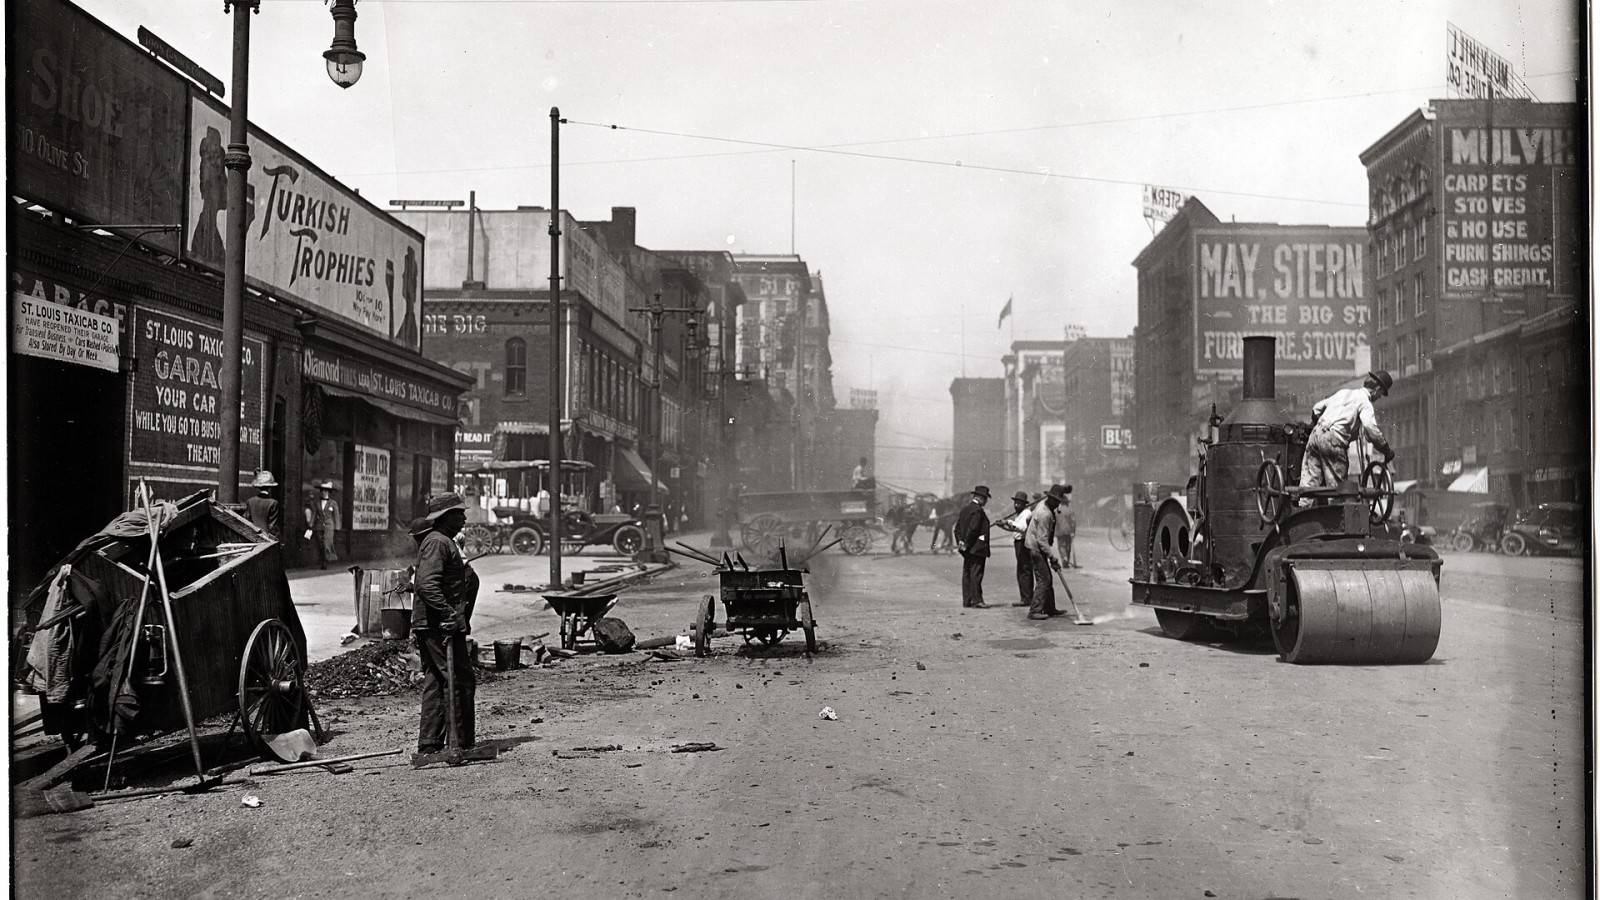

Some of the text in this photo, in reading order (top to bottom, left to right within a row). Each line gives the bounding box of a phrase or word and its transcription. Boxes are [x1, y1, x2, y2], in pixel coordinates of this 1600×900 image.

[32, 48, 124, 139] SHOE
[38, 134, 69, 171] OLIVE
[73, 151, 90, 180] ST.
[1445, 174, 1528, 192] CARPETS
[261, 165, 350, 241] TURKISH
[1454, 197, 1527, 214] STOVES
[1461, 221, 1528, 239] HOUSE
[288, 228, 376, 288] TROPHIES
[1446, 244, 1553, 262] FURNISHINGS
[1200, 243, 1364, 301] MAY, STERN
[1447, 267, 1489, 287] CASH
[21, 301, 114, 335] ST. LOUIS TAXICAB CO.
[375, 299, 383, 312] 10
[1248, 305, 1288, 324] THE
[1298, 305, 1333, 324] BIG
[25, 316, 41, 328] HAVE
[43, 320, 72, 335] REOPENED
[74, 327, 90, 338] THEIR
[423, 314, 487, 333] NE BIG
[28, 337, 40, 350] Also
[41, 339, 57, 353] Stored
[59, 343, 66, 356] By
[67, 345, 76, 359] Day
[75, 336, 86, 348] Cars
[145, 319, 163, 342] ST.
[163, 323, 194, 350] LOUIS
[198, 334, 223, 358] TAXIC
[154, 350, 224, 390] GARA
[303, 348, 340, 384] Diamond
[155, 385, 188, 410] YOUR
[193, 394, 216, 414] CAR
[373, 372, 455, 411] ST. LOUIS TAXICAB CO.
[135, 409, 161, 432] WHILE
[162, 412, 177, 434] YOU
[178, 415, 189, 436] GO
[189, 418, 200, 437] TO
[201, 419, 221, 440] BUSIN
[248, 427, 260, 445] THE
[464, 432, 483, 443] READ
[483, 433, 491, 443] IT
